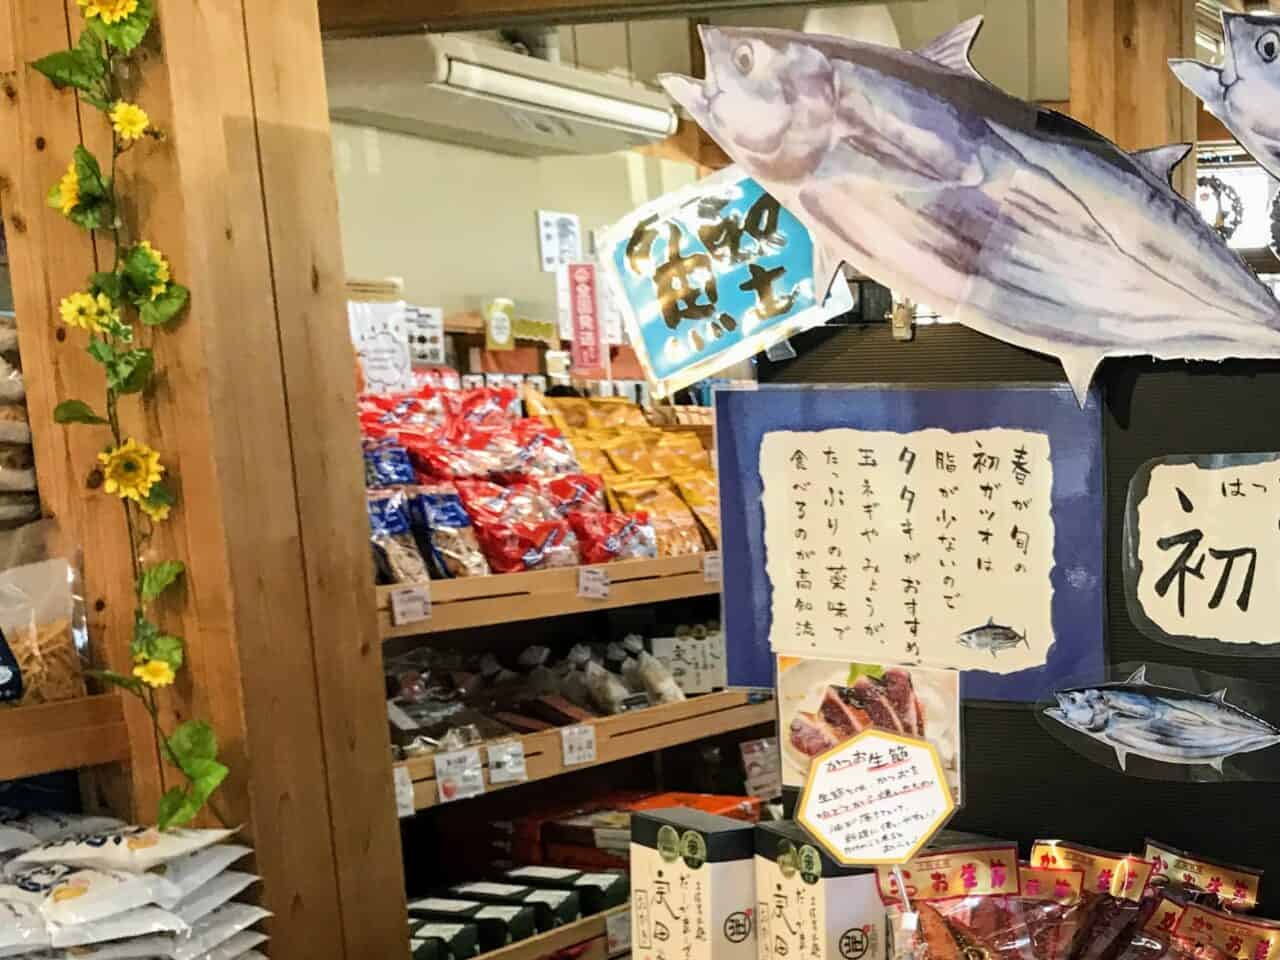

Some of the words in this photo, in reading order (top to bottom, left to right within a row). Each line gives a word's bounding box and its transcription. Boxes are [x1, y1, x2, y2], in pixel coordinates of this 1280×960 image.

[936, 451, 961, 609] 脂が少ないので
[973, 439, 1001, 572] 初ガツオは
[1011, 444, 1032, 573] 春が旬の
